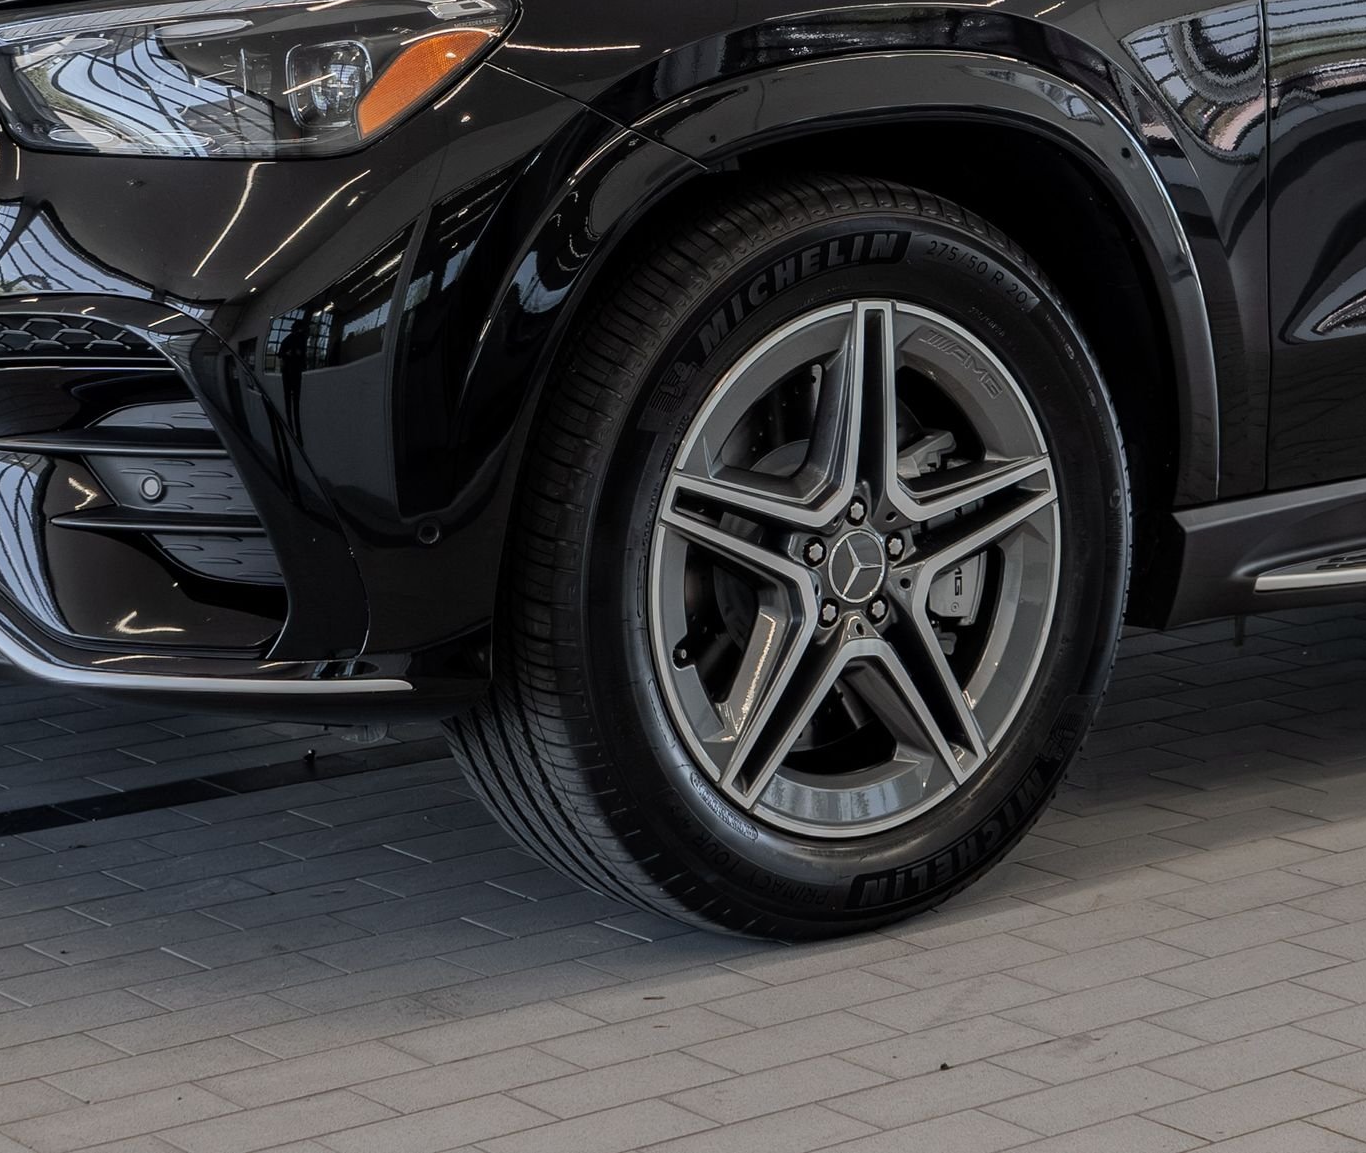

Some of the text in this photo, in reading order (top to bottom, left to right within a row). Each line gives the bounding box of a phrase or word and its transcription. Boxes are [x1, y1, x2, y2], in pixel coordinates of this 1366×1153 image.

[697, 232, 899, 356] MICHELIN
[926, 239, 1029, 305] 275/50 R 20
[860, 768, 1047, 906] MICHELIN
